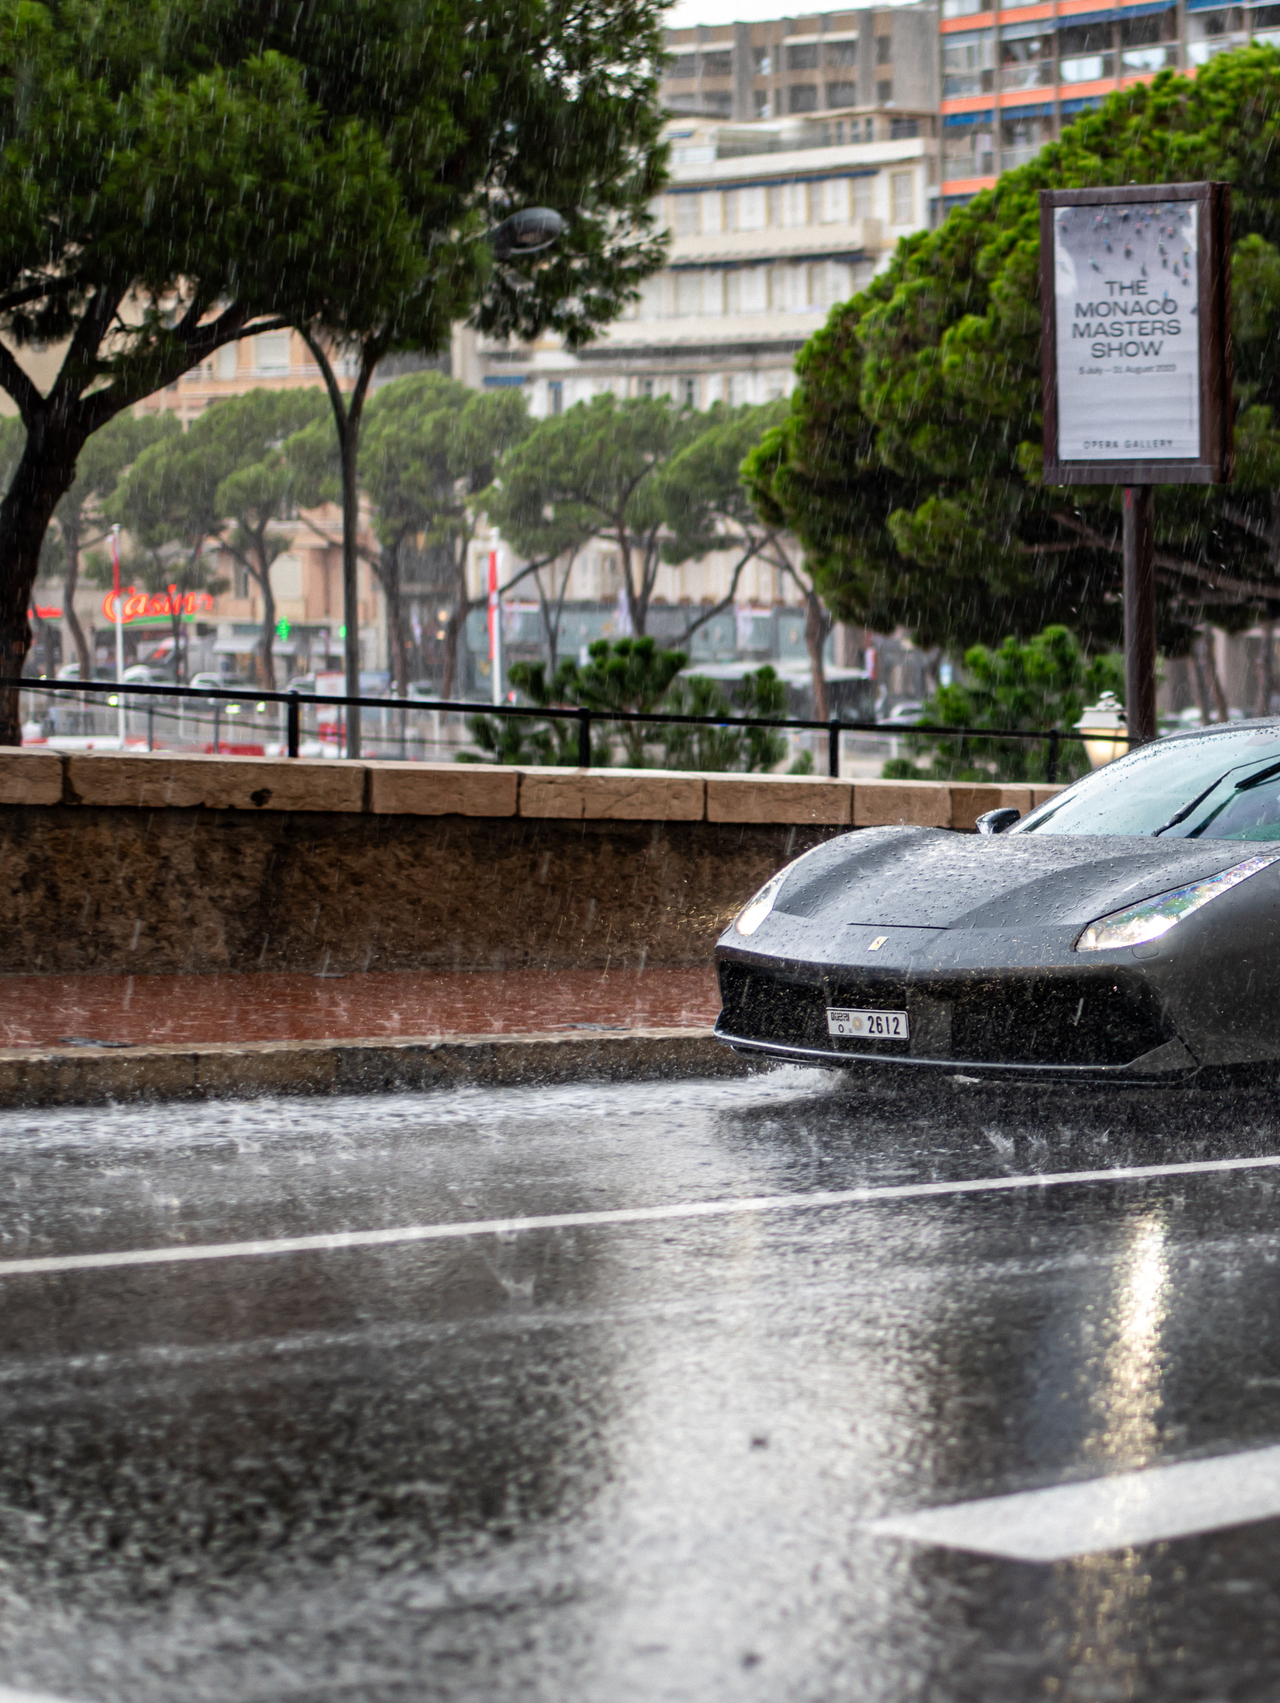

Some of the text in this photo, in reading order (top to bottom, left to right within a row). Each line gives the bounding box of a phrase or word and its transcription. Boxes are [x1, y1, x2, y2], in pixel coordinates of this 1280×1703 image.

[1104, 280, 1148, 296] THE
[1075, 299, 1178, 318] MONACO
[1072, 319, 1181, 338] MASTERS
[1091, 340, 1164, 358] SHOW
[1083, 439, 1173, 450] OPERA GALLERY
[867, 1015, 901, 1035] 2612
